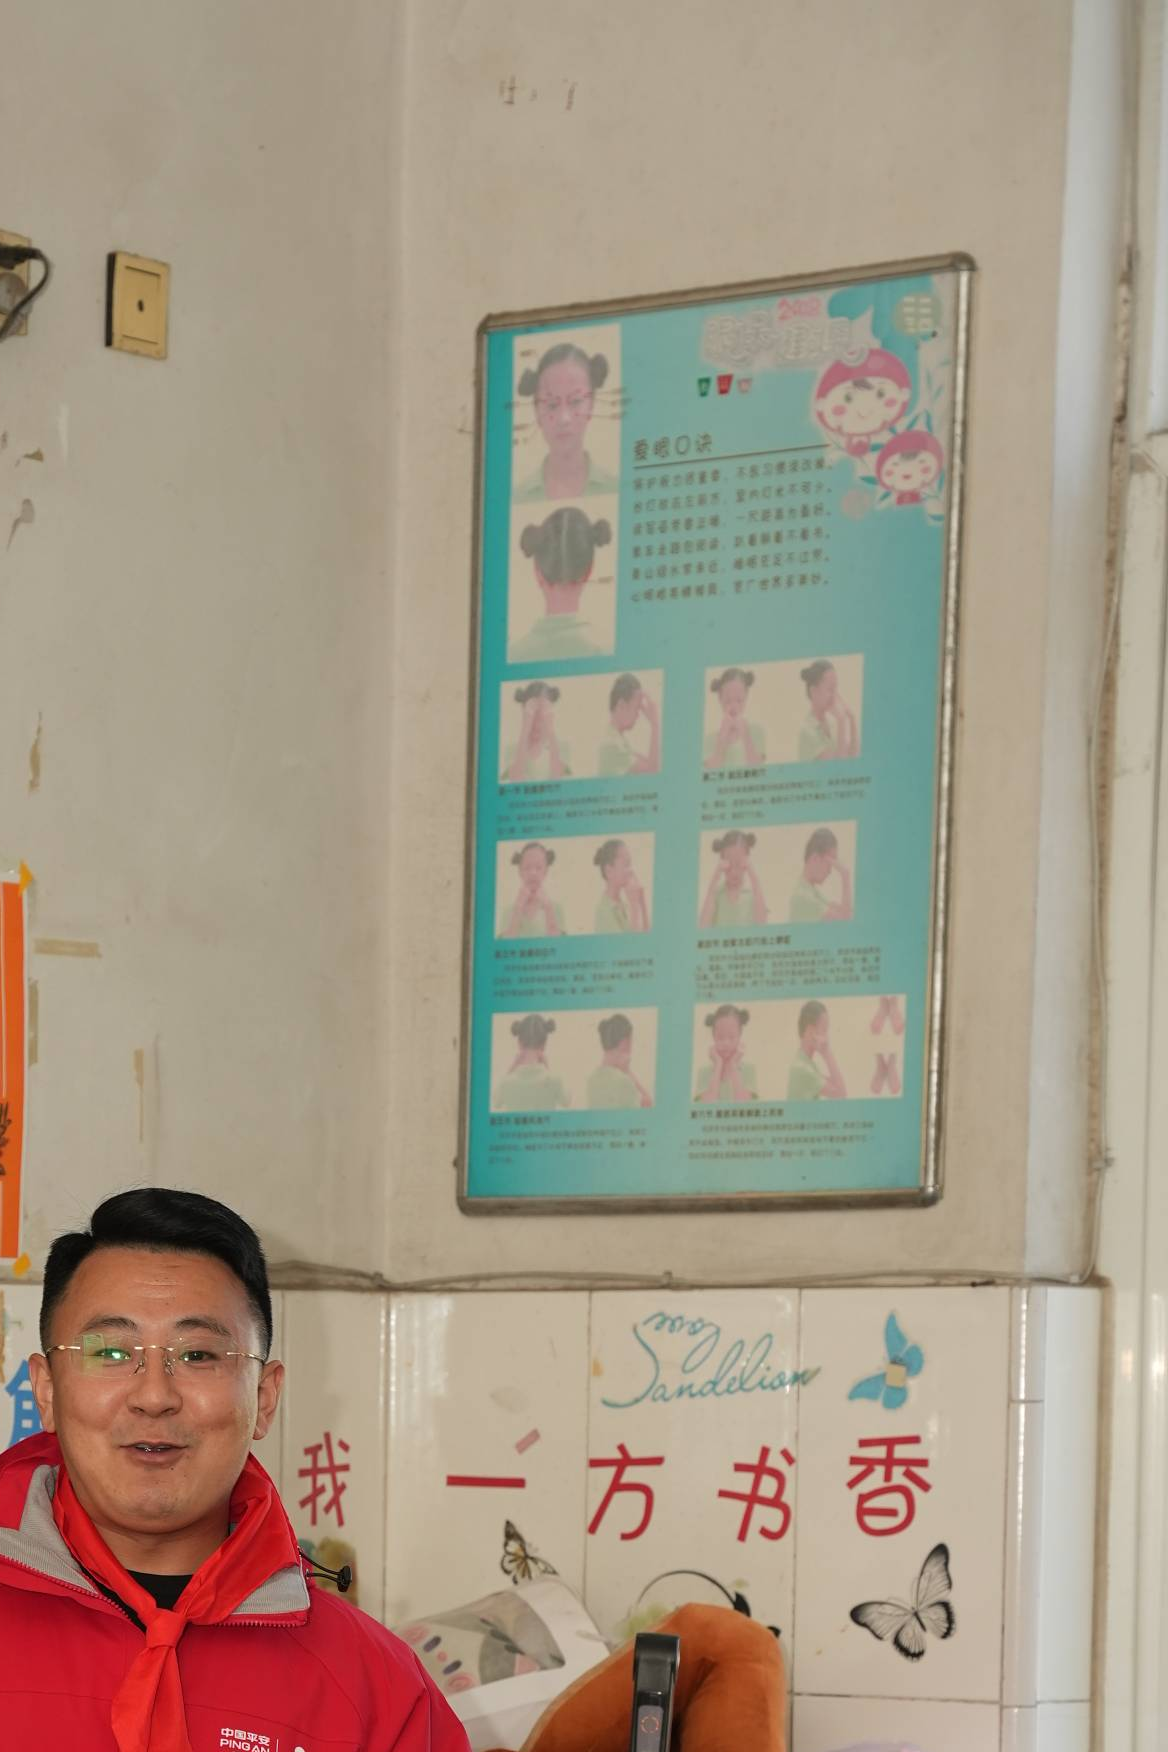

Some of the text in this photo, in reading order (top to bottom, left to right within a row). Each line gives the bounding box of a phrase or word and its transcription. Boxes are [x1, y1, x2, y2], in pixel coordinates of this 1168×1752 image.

[220, 1728, 270, 1746] 中国平安
[220, 1738, 251, 1751] PING
